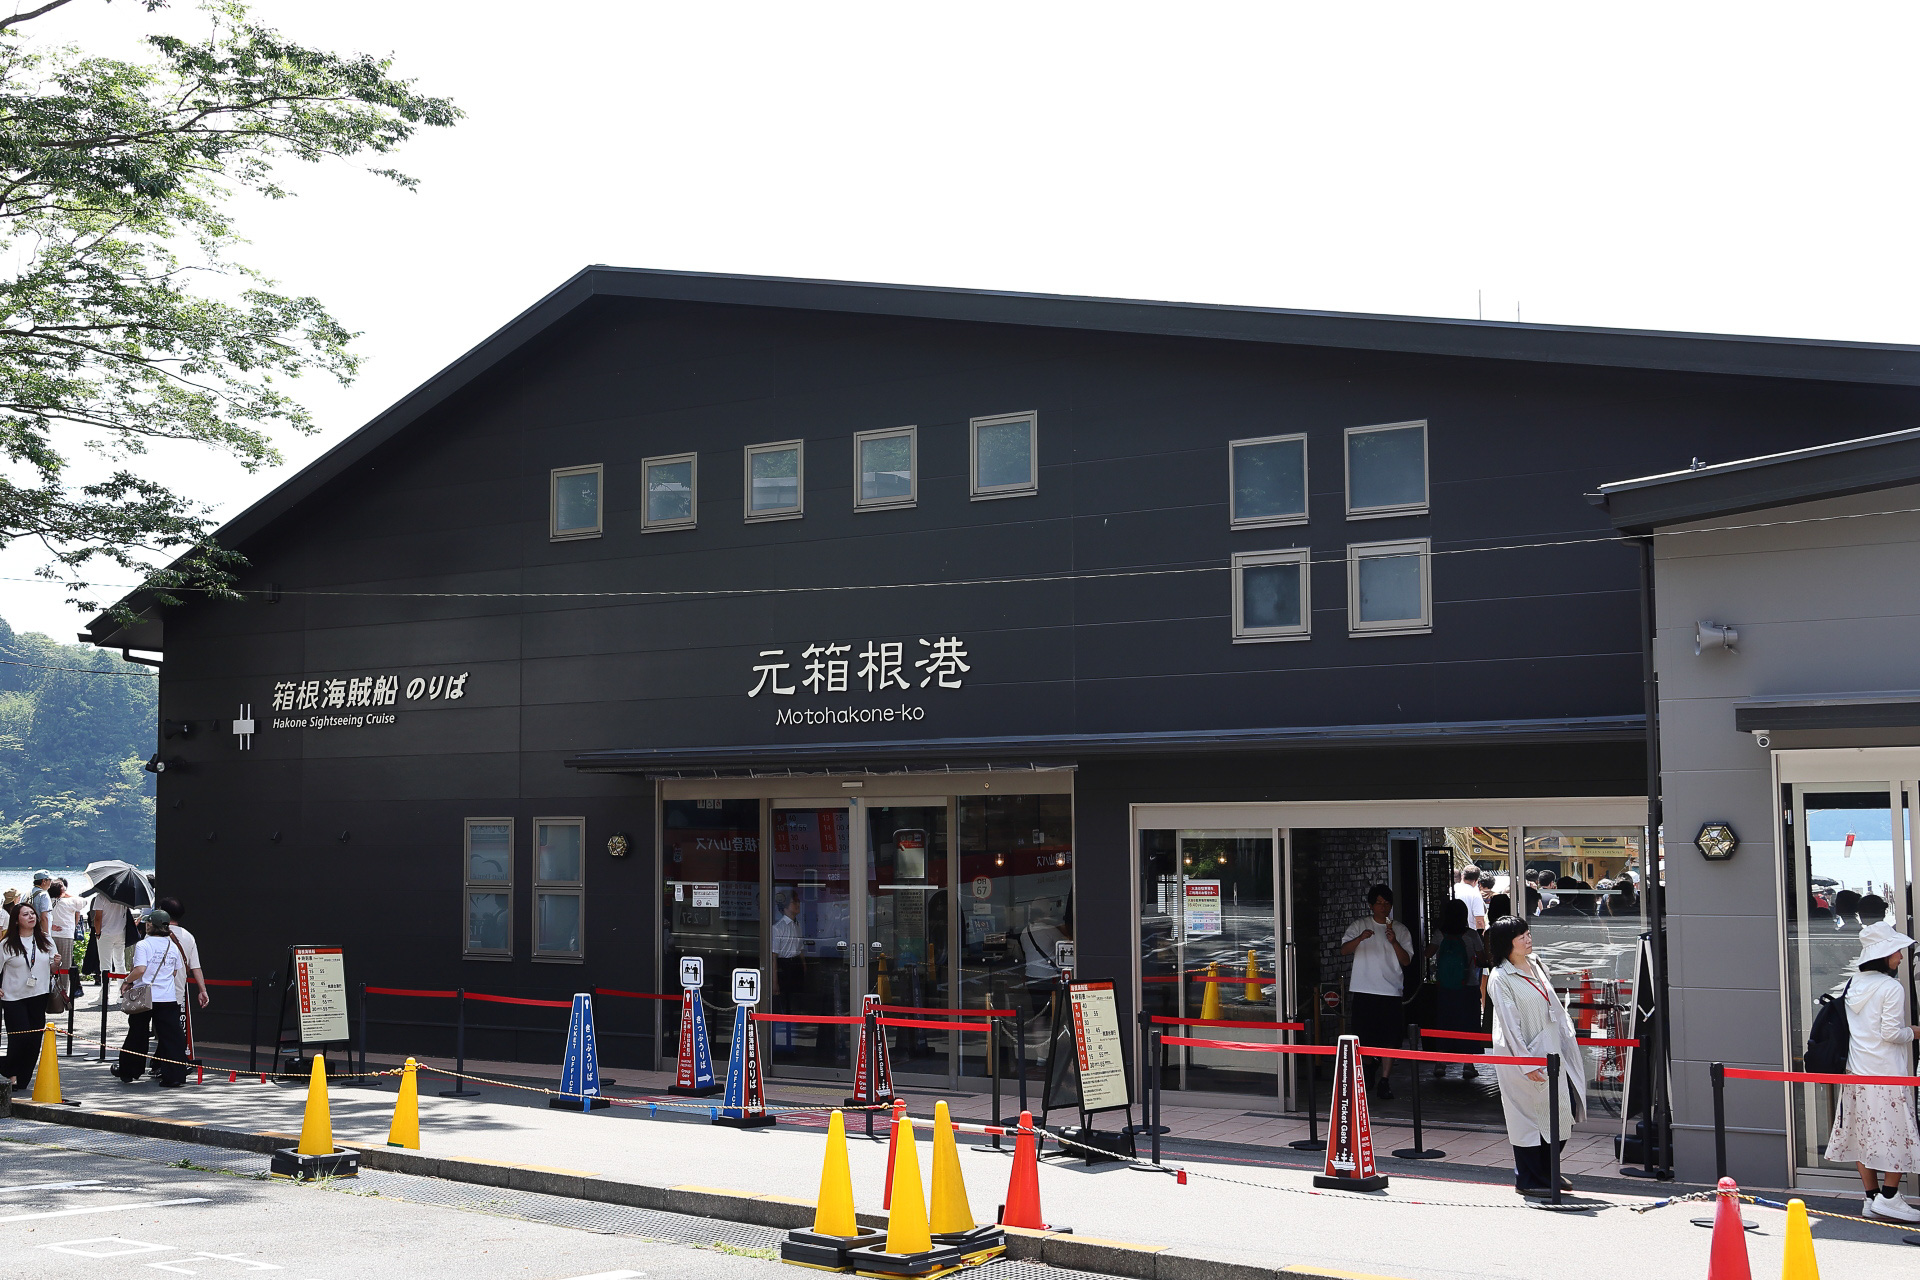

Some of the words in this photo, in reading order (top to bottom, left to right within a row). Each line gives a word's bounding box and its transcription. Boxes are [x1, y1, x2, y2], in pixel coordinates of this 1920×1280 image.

[747, 636, 971, 697] 元箱根港
[272, 675, 399, 711] 箱根海賊船
[406, 672, 469, 700] のりば
[272, 718, 307, 729] Hakone
[309, 714, 363, 730] Sightseeing
[365, 712, 395, 725] Cruise
[775, 703, 925, 726] Motohakone-ko
[976, 886, 987, 895] 67
[572, 1012, 580, 1049] TICKET
[696, 1015, 707, 1069] きっぷうりば
[585, 1023, 594, 1082] きっぷうりば
[568, 1055, 576, 1093] OFFICE
[748, 1060, 757, 1089] のりば
[1341, 1098, 1349, 1124] Ticket
[1340, 1125, 1348, 1144] Gate
